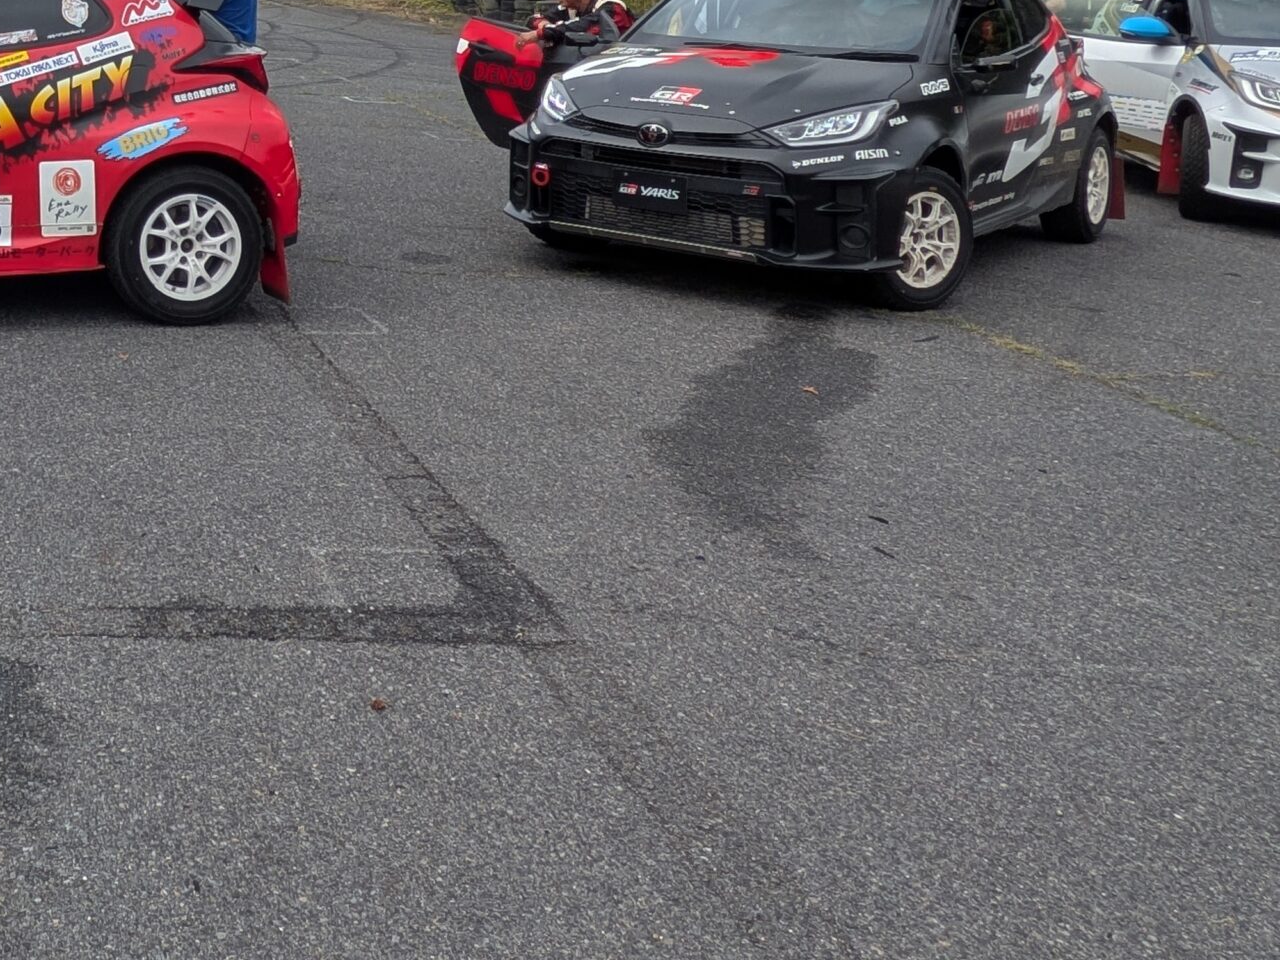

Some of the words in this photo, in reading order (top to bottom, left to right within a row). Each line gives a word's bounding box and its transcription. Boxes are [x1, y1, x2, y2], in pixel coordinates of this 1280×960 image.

[4, 66, 31, 82] TOKAI
[31, 61, 53, 76] RIKA
[473, 61, 536, 91] DENSO
[30, 54, 135, 125] CITY
[921, 79, 950, 95] RAYS
[654, 90, 694, 102] GR
[801, 155, 845, 167] DUNLOP
[855, 148, 889, 160] AISIN
[639, 185, 680, 200] YARIS
[48, 198, 72, 212] Ena
[54, 204, 88, 223] Rally
